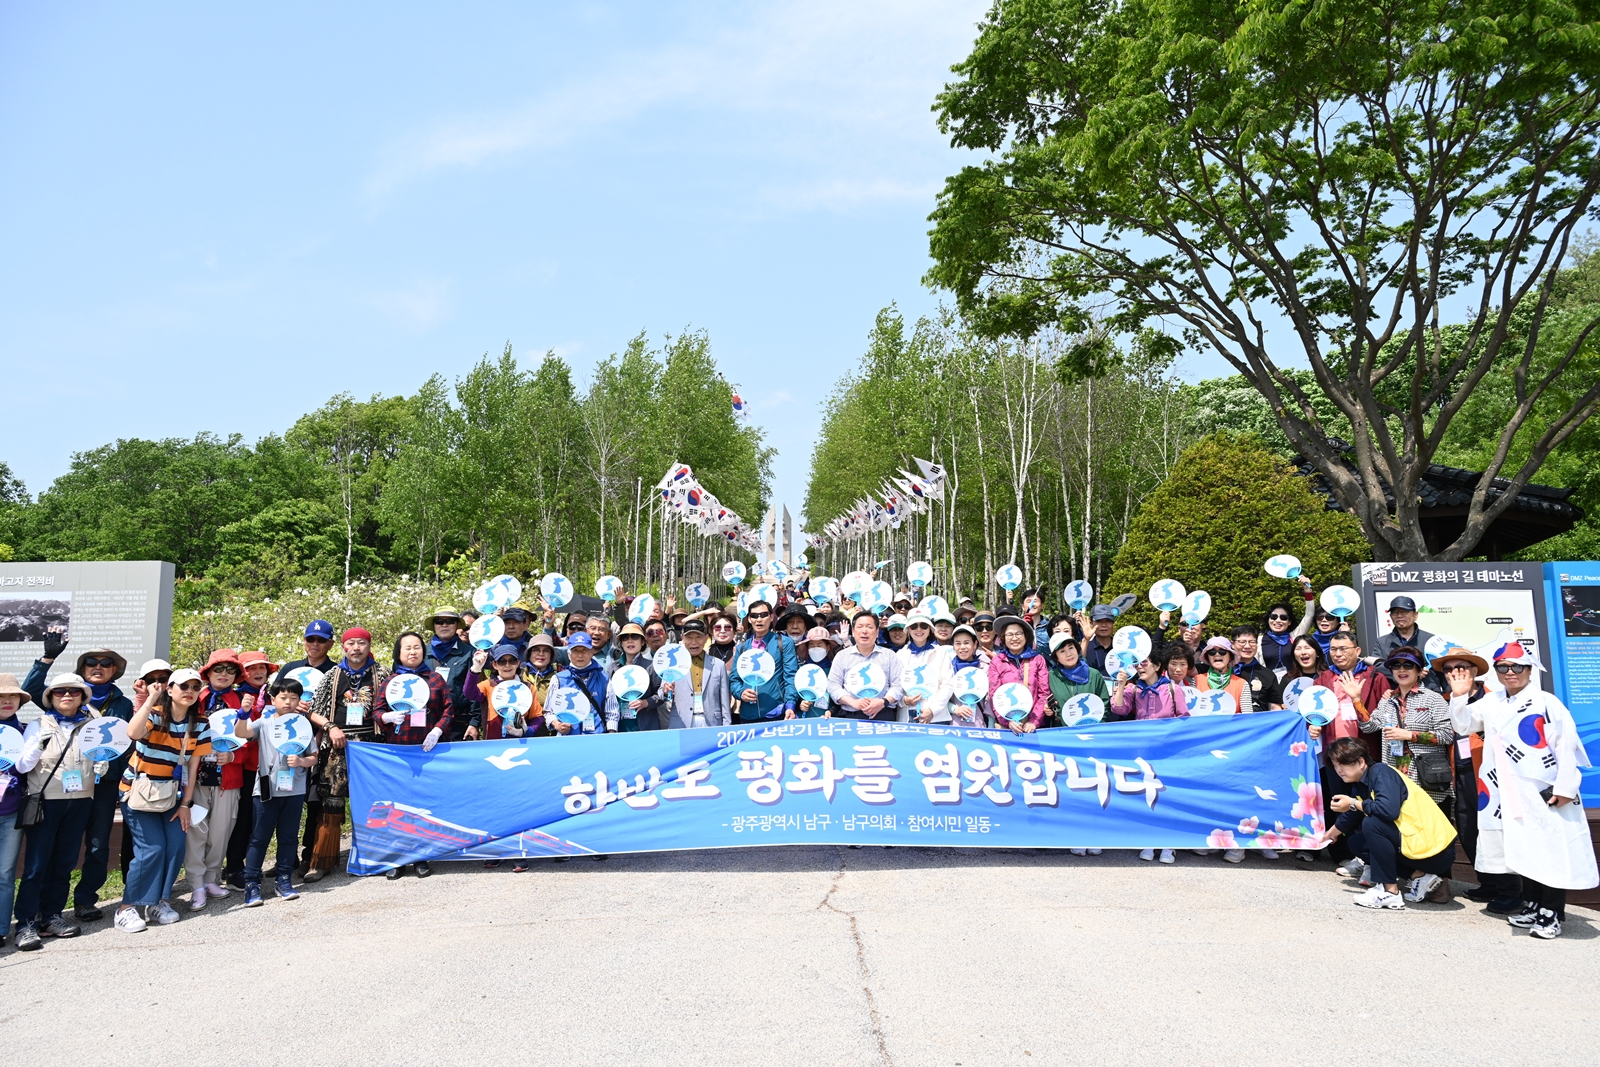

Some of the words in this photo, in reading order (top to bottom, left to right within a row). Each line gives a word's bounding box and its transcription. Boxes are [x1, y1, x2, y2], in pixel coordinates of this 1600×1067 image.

[26, 575, 55, 586] 전적비
[1391, 571, 1420, 583] DMZ
[1422, 570, 1458, 583] 평화의
[1461, 570, 1474, 583] 길
[1476, 569, 1524, 583] 테마노선
[717, 728, 755, 748] 2024
[760, 724, 811, 738] 상반기
[817, 722, 852, 736] 남구
[560, 760, 721, 815] 한반도
[735, 744, 900, 804] 평화를
[914, 742, 1164, 808] 염원합니다
[730, 814, 800, 833] 광주광역시
[803, 814, 831, 832] 남구
[842, 813, 897, 832] 남구의회
[907, 814, 961, 833] 참여시민
[965, 815, 991, 833] 일동
